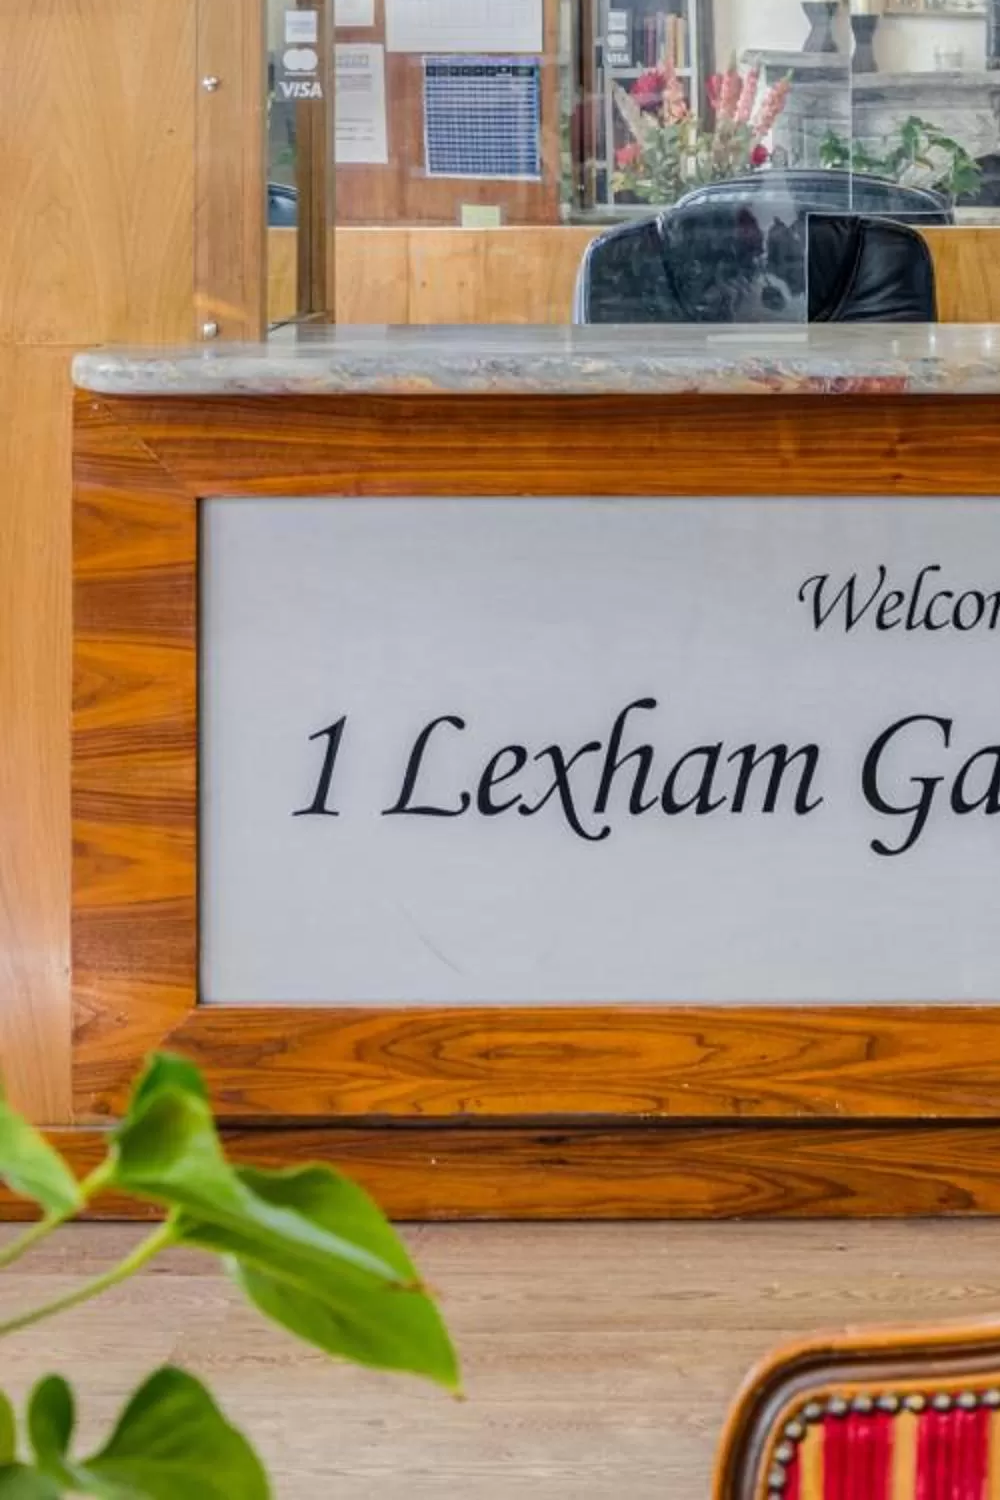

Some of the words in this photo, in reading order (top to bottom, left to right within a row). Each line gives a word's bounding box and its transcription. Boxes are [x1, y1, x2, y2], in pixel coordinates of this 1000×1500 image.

[279, 81, 323, 98] VISA
[292, 715, 347, 817] 1
[381, 697, 824, 842] Lexham
